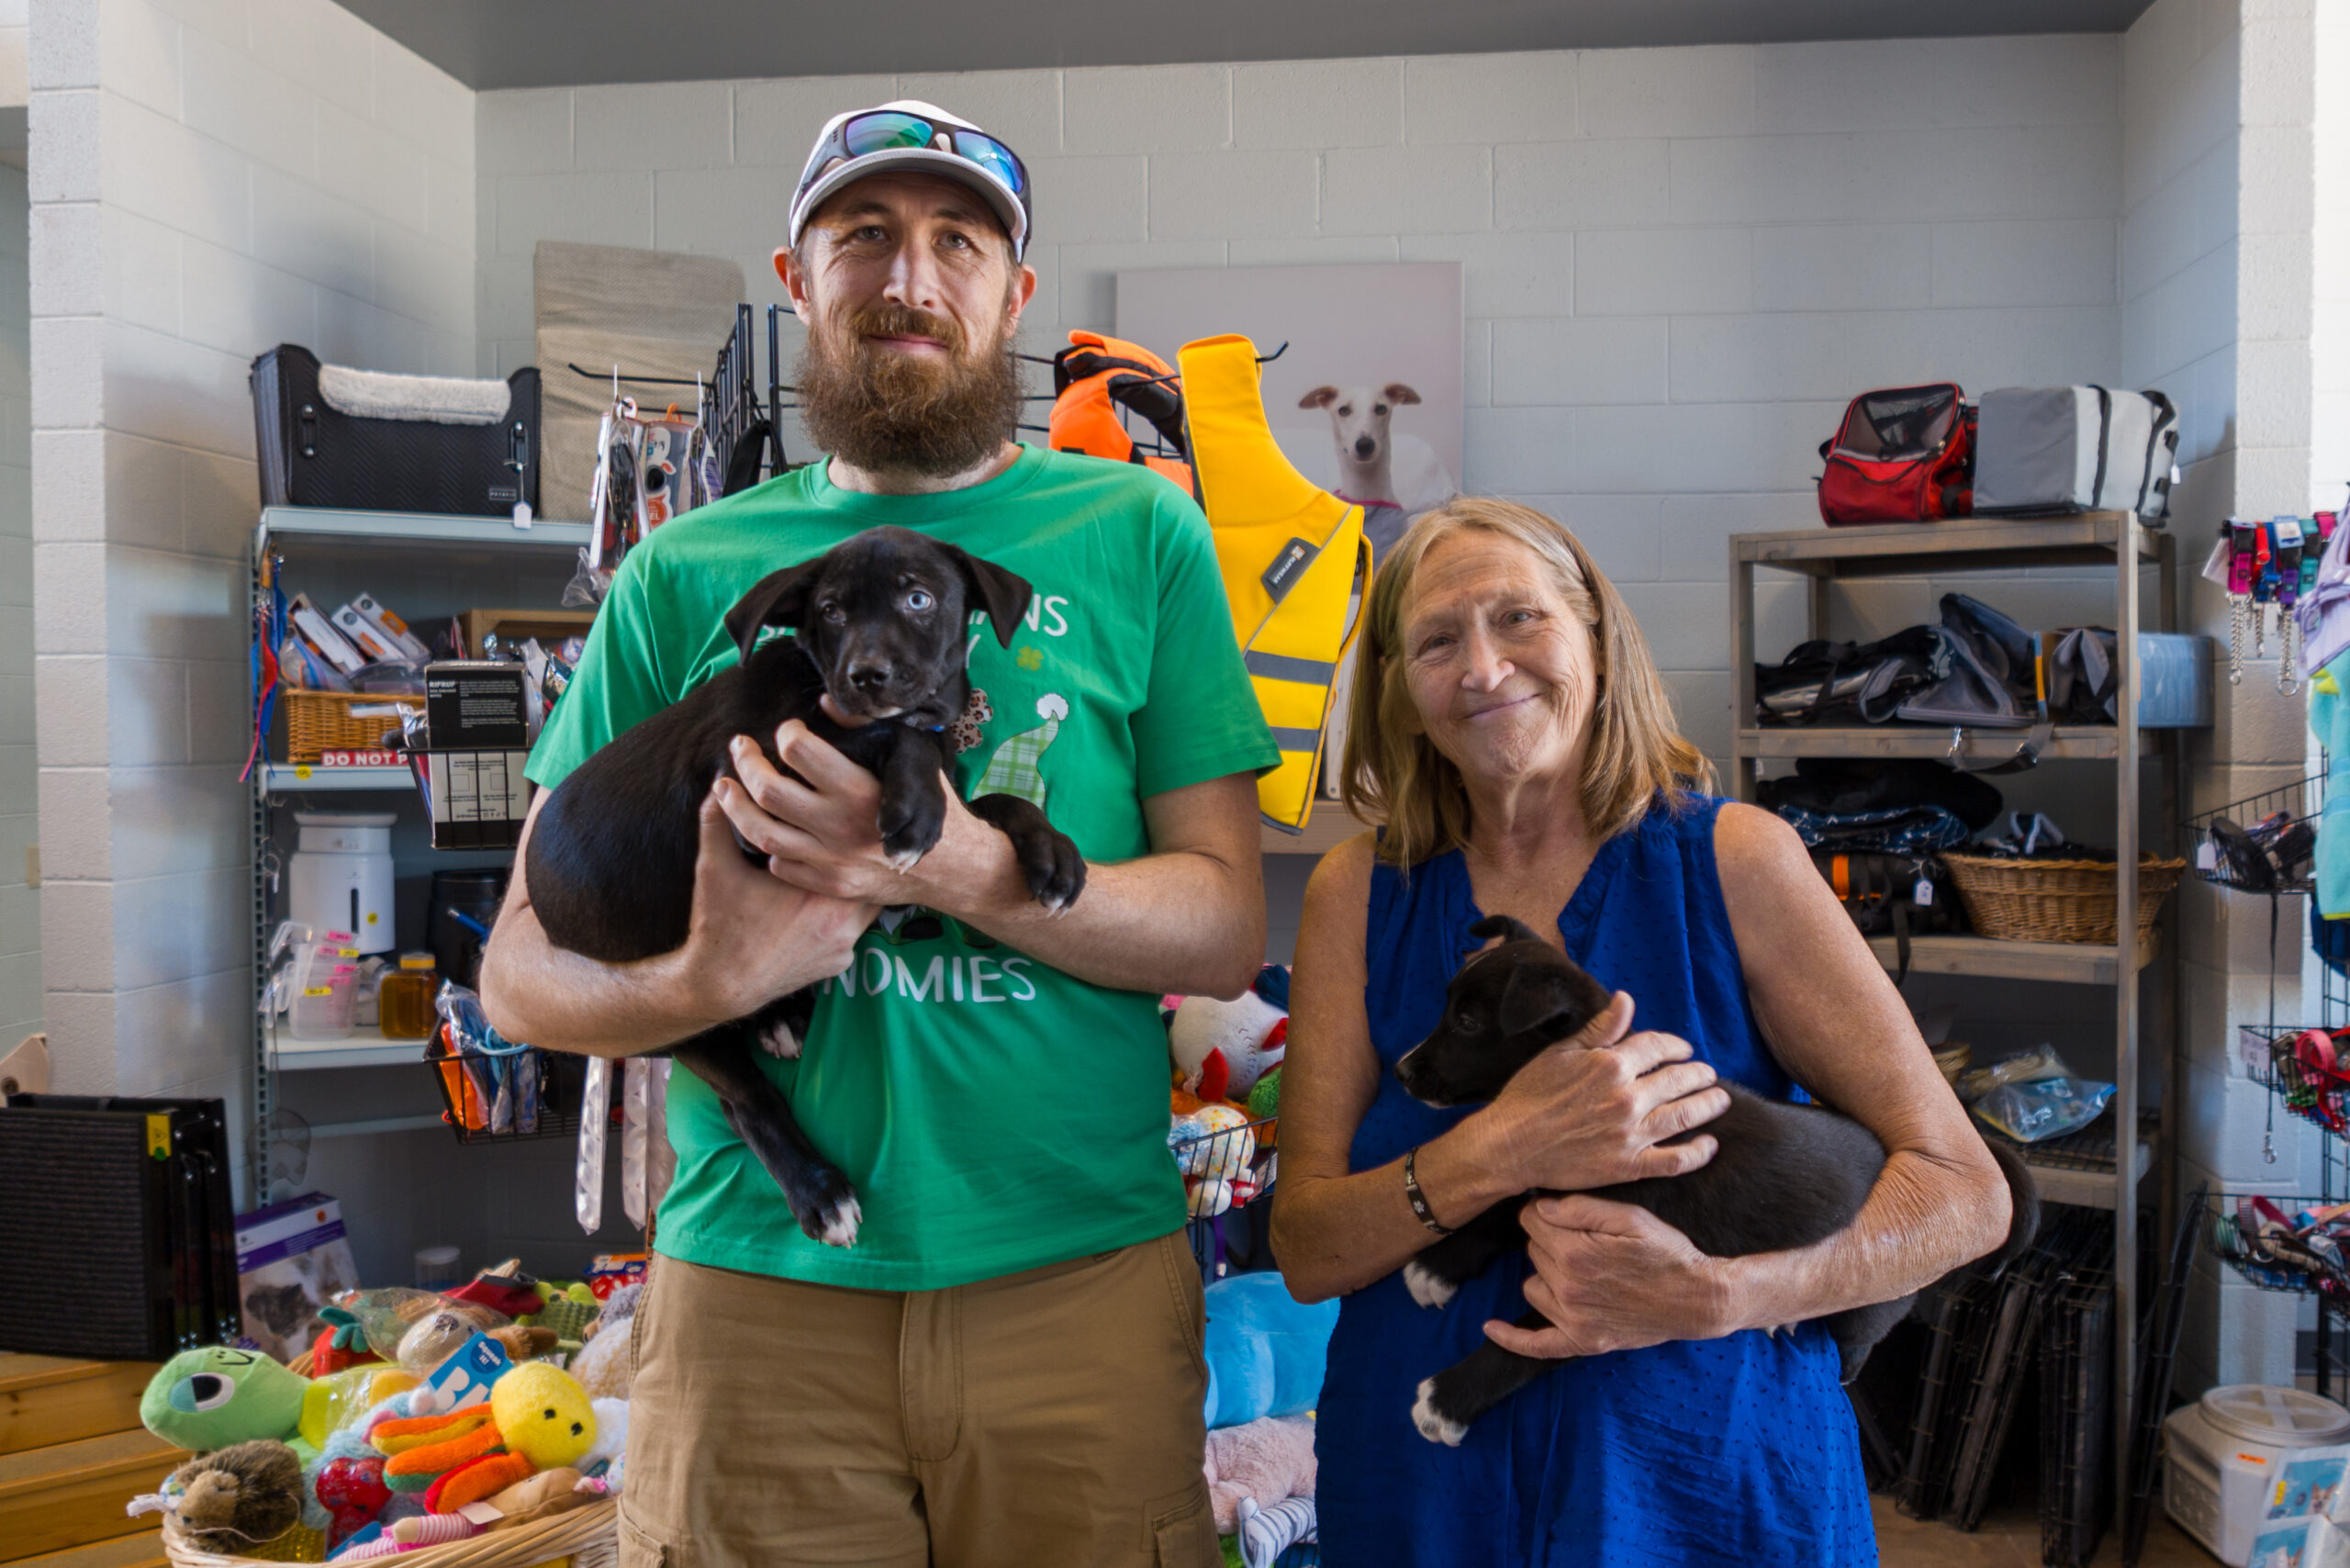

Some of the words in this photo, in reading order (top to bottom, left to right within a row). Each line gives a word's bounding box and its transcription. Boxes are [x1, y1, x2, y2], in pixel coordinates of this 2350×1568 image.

[323, 754, 350, 766] DO
[355, 754, 392, 766] NOT
[822, 947, 1036, 1003] NOMIES
[478, 1341, 501, 1366] Squeak
